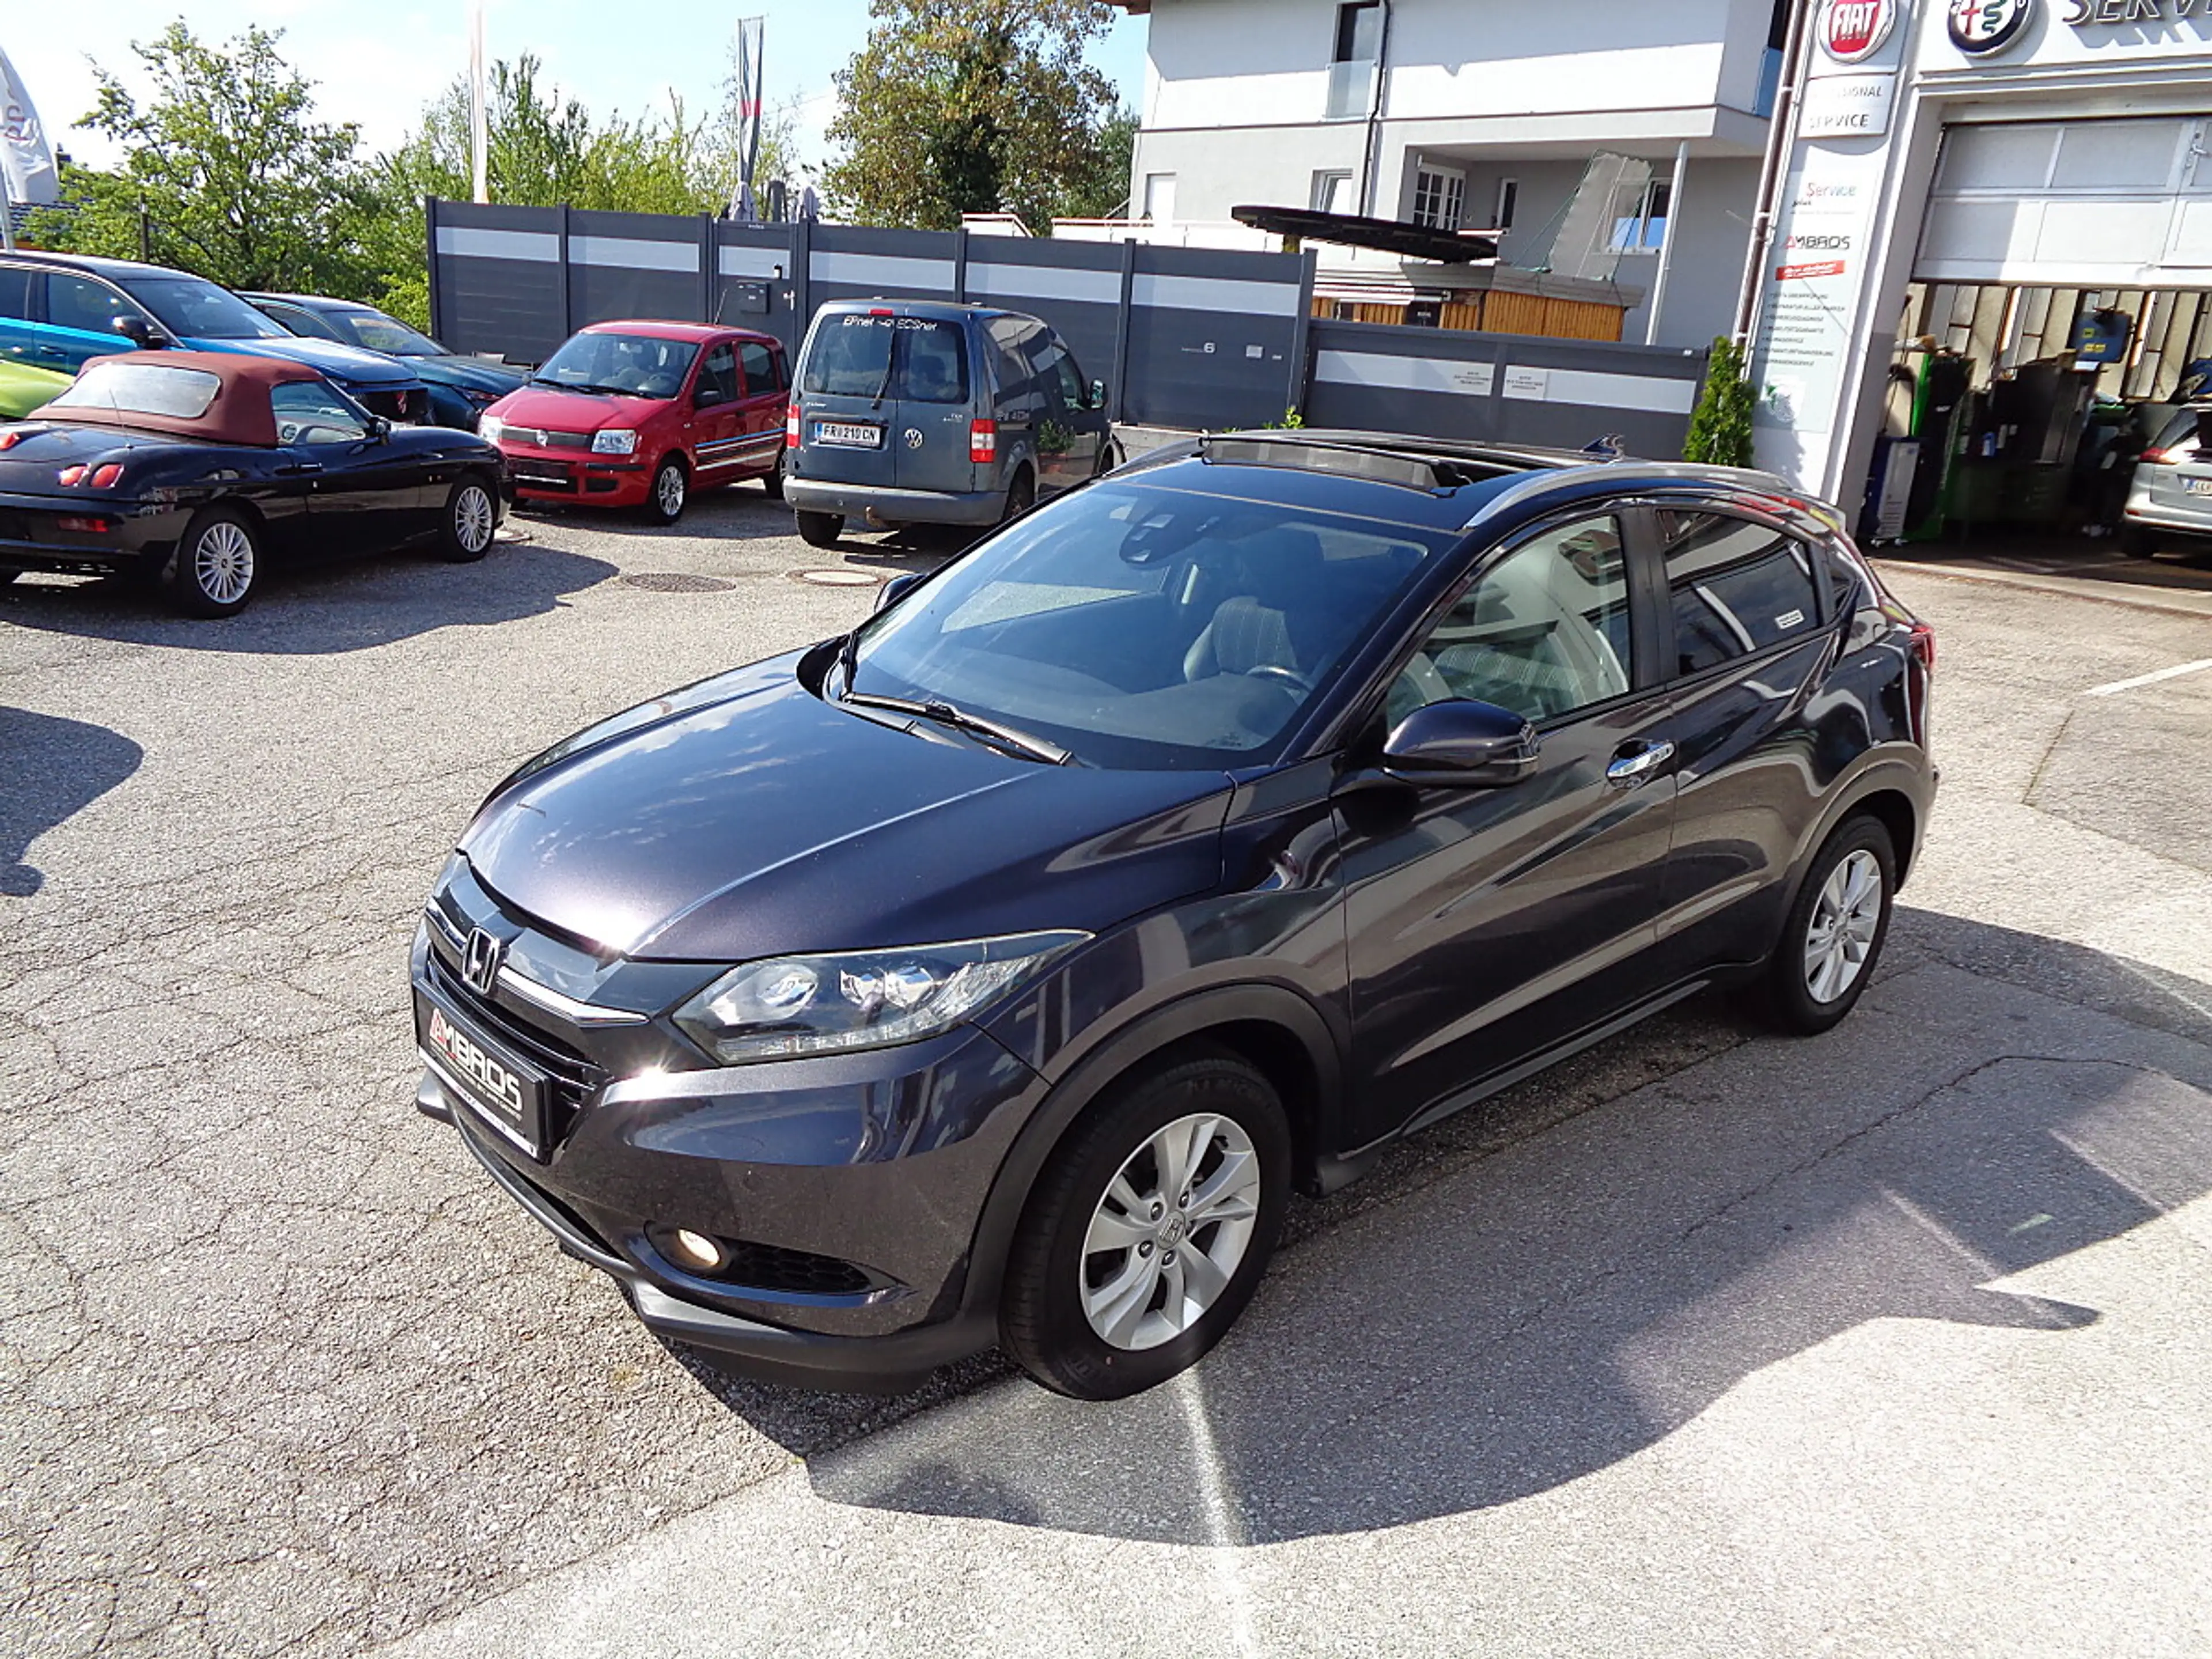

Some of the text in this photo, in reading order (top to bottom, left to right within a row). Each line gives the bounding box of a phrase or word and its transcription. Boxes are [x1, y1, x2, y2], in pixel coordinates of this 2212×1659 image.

[1832, 2, 1879, 41] FIAT
[2062, 0, 2212, 25] SERV
[429, 1007, 522, 1111] AMBROS
